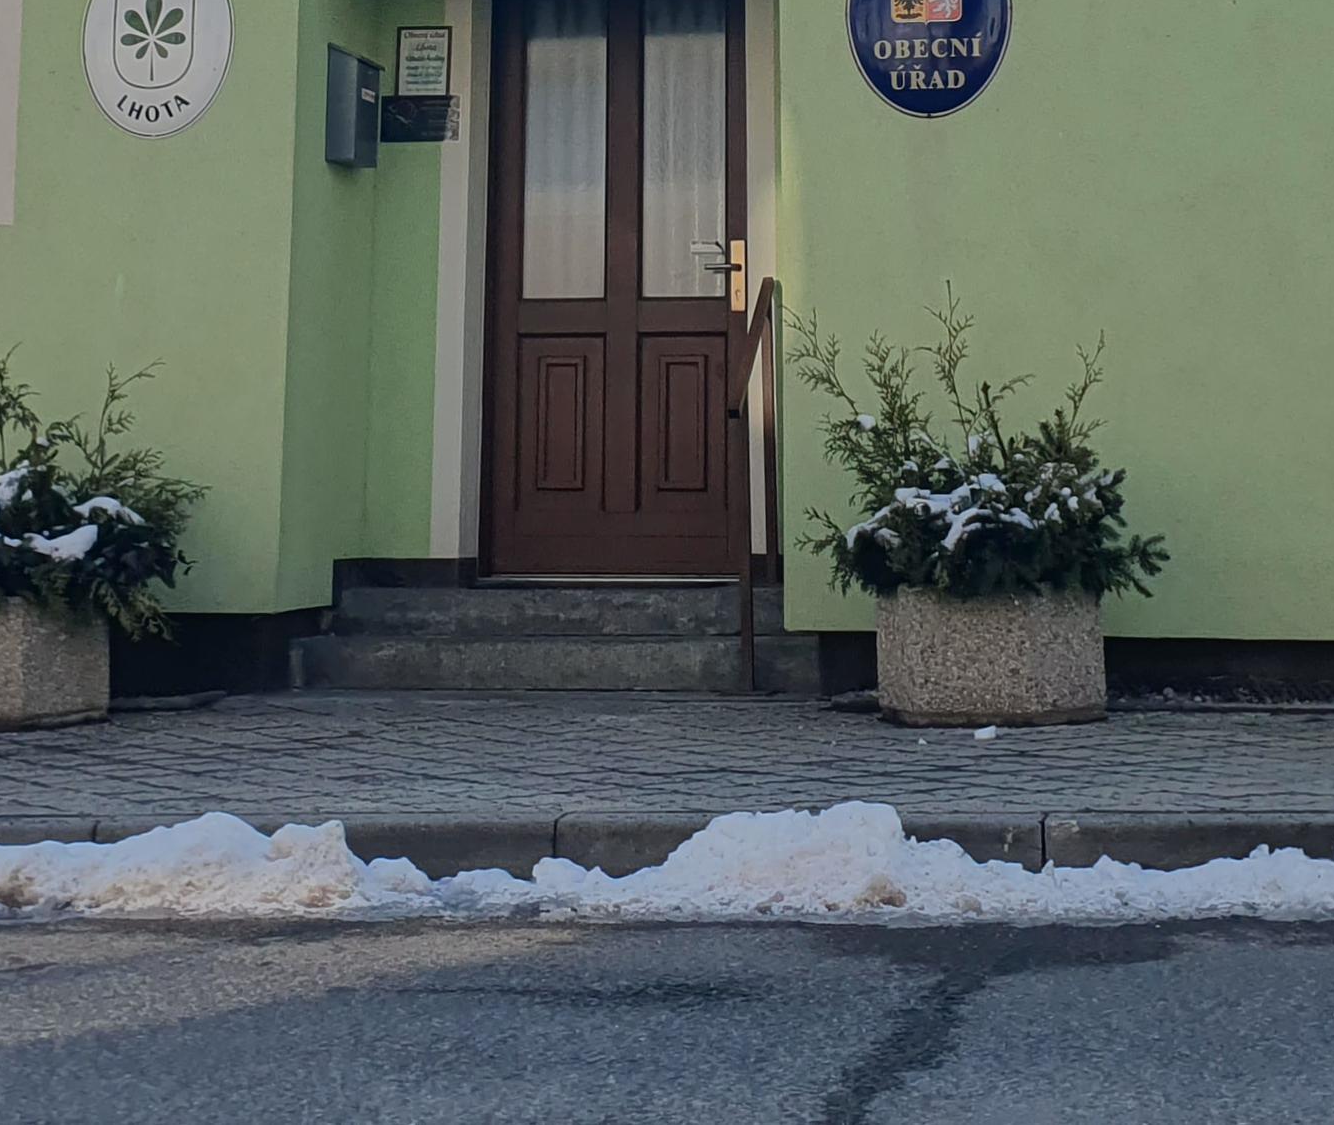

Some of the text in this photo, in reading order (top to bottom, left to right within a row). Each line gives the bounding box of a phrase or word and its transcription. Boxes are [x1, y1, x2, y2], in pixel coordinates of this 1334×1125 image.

[873, 32, 982, 59] OBECNÍ
[889, 64, 966, 91] ÚŘAD
[116, 94, 191, 122] LHOTA
